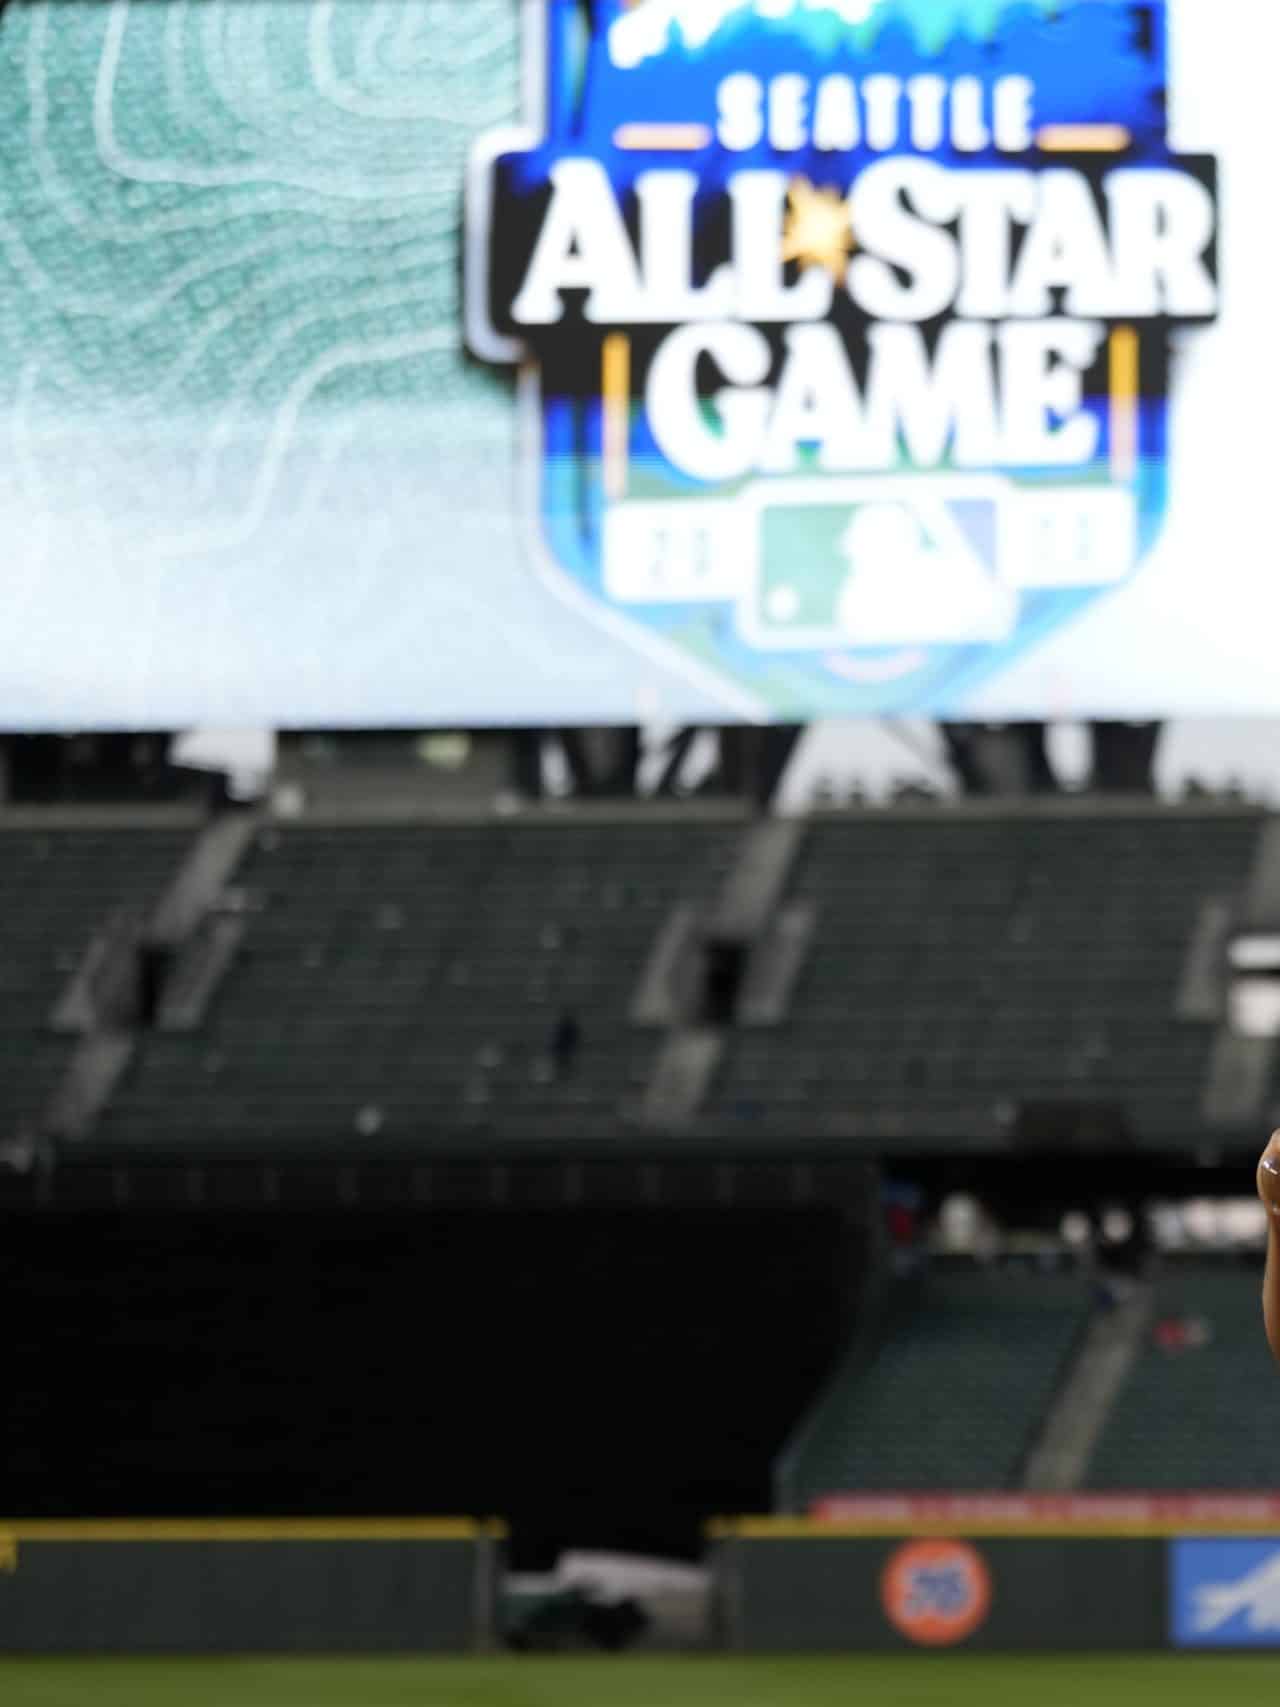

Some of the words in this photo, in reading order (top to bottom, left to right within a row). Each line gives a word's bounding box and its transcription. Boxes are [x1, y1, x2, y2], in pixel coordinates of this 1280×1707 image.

[717, 73, 1034, 152] SEATTLE
[512, 158, 832, 323] ALL
[846, 156, 1218, 321] STAR
[646, 318, 1104, 479] GAME
